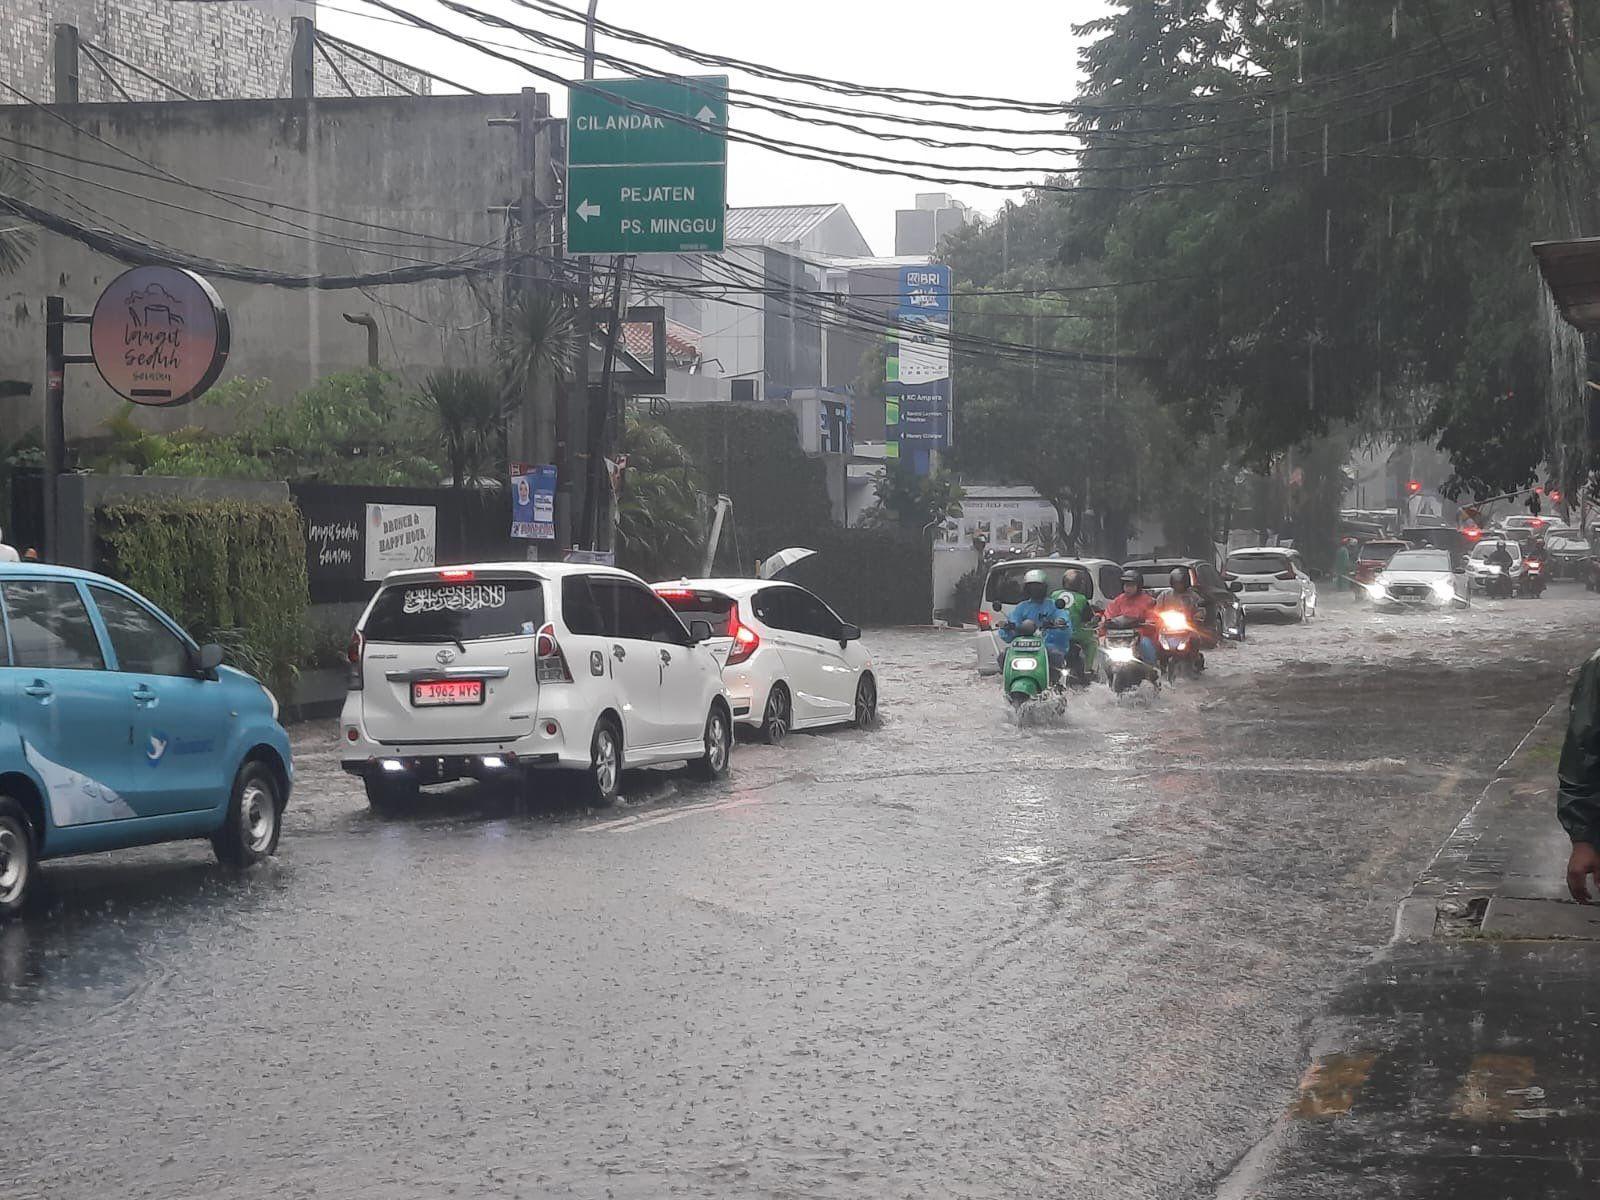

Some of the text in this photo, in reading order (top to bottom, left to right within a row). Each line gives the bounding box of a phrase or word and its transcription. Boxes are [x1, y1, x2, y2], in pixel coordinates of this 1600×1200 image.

[576, 114, 665, 130] CILANDAK
[620, 187, 695, 202] PEJATEN
[620, 218, 717, 234] PS. MINGGU
[920, 273, 940, 285] BRI
[124, 346, 179, 369] Seduh
[378, 527, 426, 553] HAPPY HOUR
[413, 545, 434, 563] 20%
[415, 687, 422, 698] B
